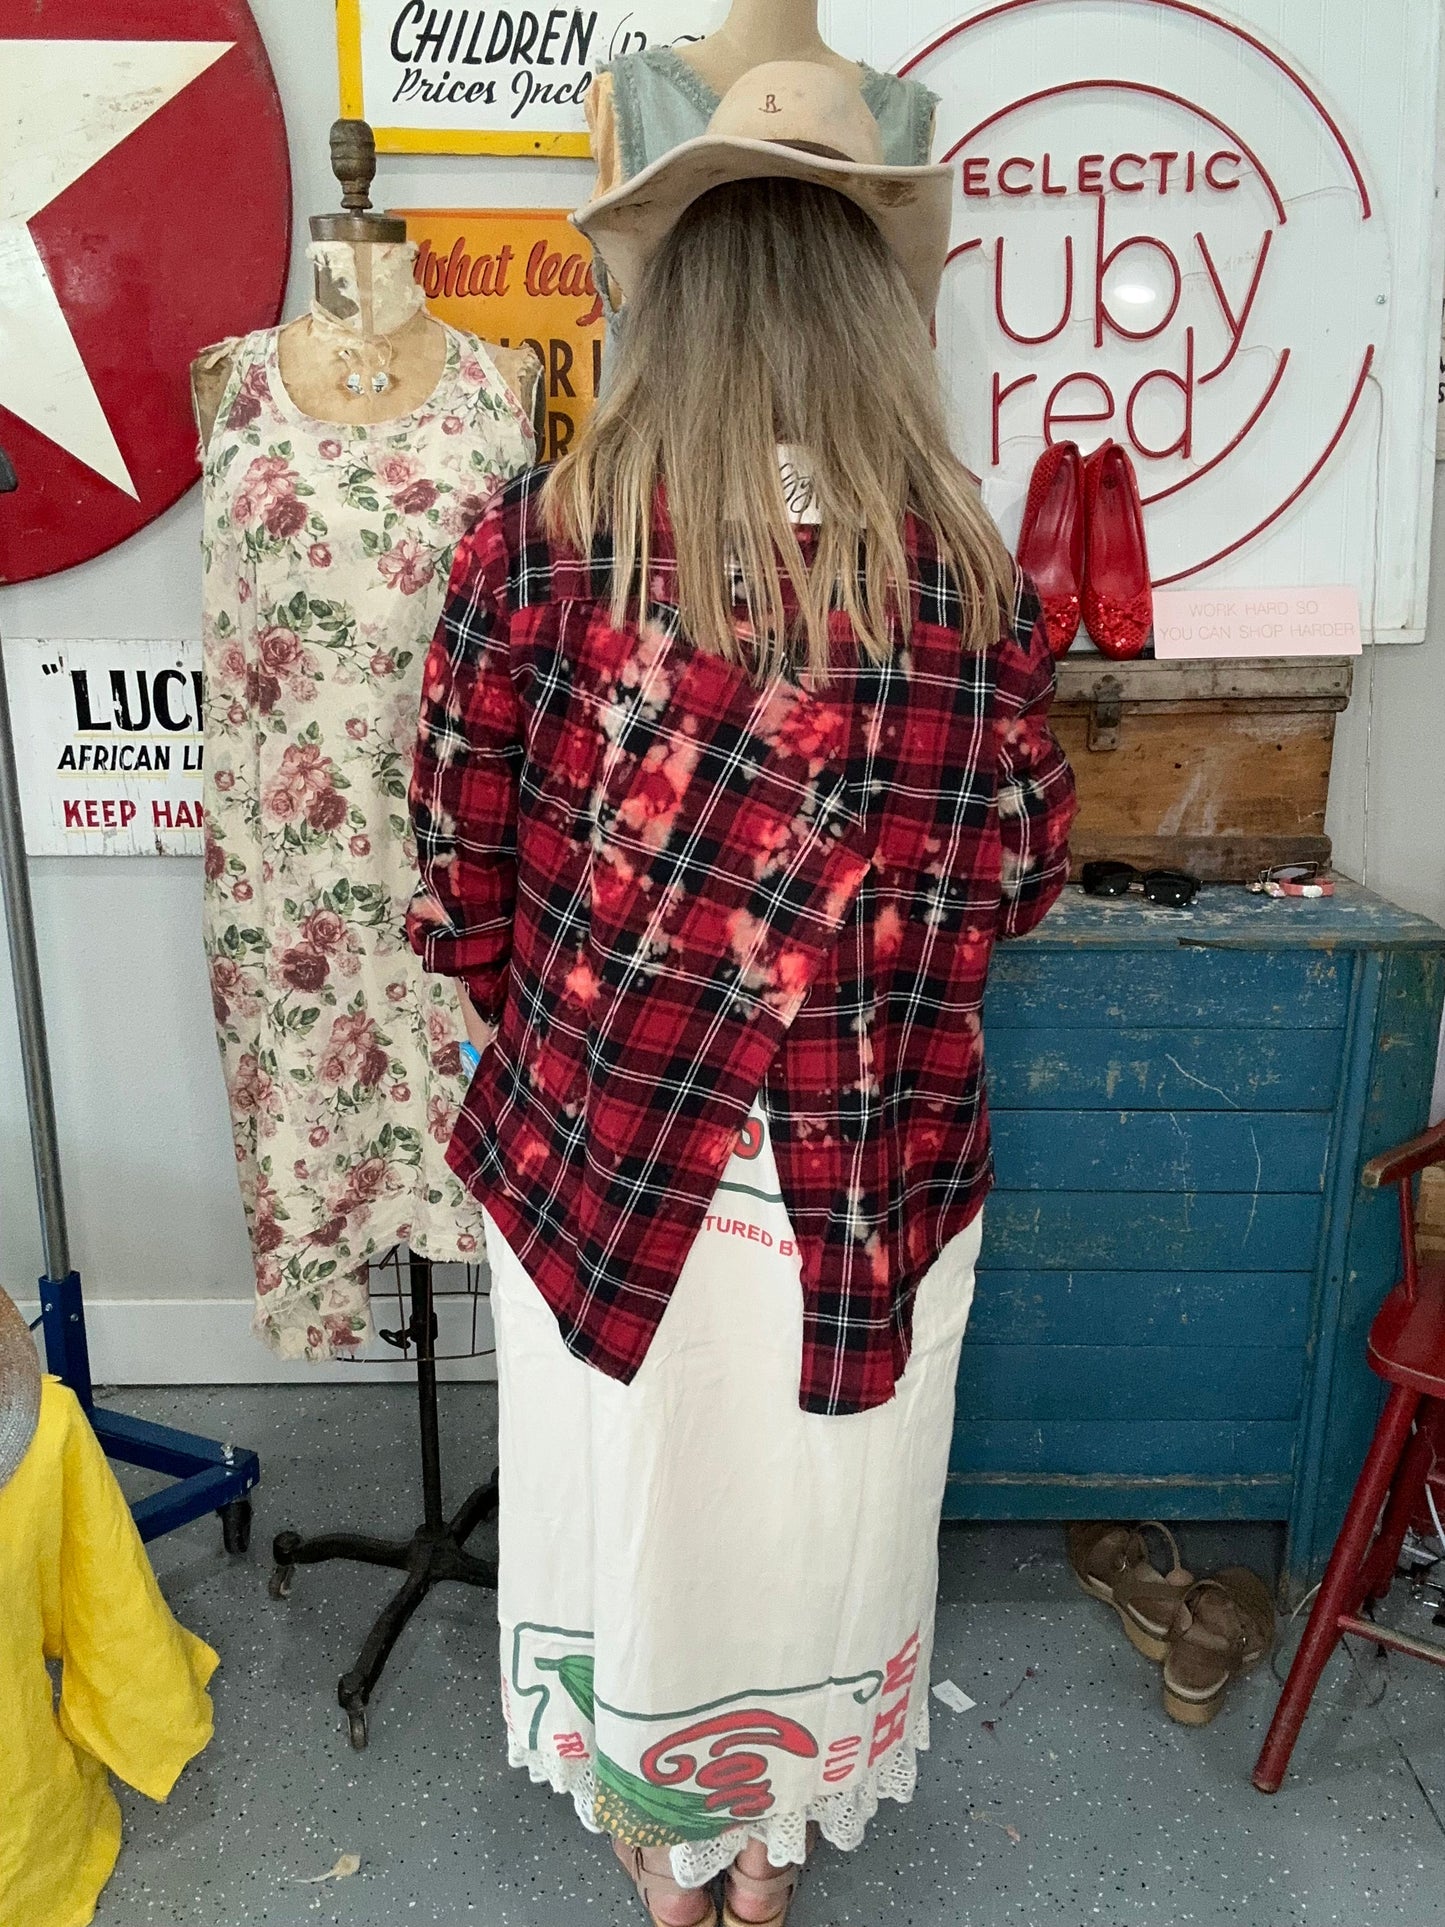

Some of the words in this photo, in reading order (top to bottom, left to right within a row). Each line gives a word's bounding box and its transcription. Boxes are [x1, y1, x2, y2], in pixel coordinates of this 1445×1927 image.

[390, 0, 598, 66] CHILDREN
[392, 68, 498, 104] Prices
[962, 149, 1243, 197] ECLECTIC
[930, 189, 1274, 385] ruby
[992, 326, 1195, 466] red
[1188, 602, 1238, 618] WORK
[1245, 601, 1289, 617] HARD
[1297, 600, 1319, 615] SO
[1159, 626, 1193, 642] YOU
[1198, 625, 1231, 641] CAN
[1239, 623, 1284, 640] SHOP
[1290, 622, 1356, 638] HARDER
[57, 745, 171, 771] AFRICAN
[63, 799, 137, 828] KEEP
